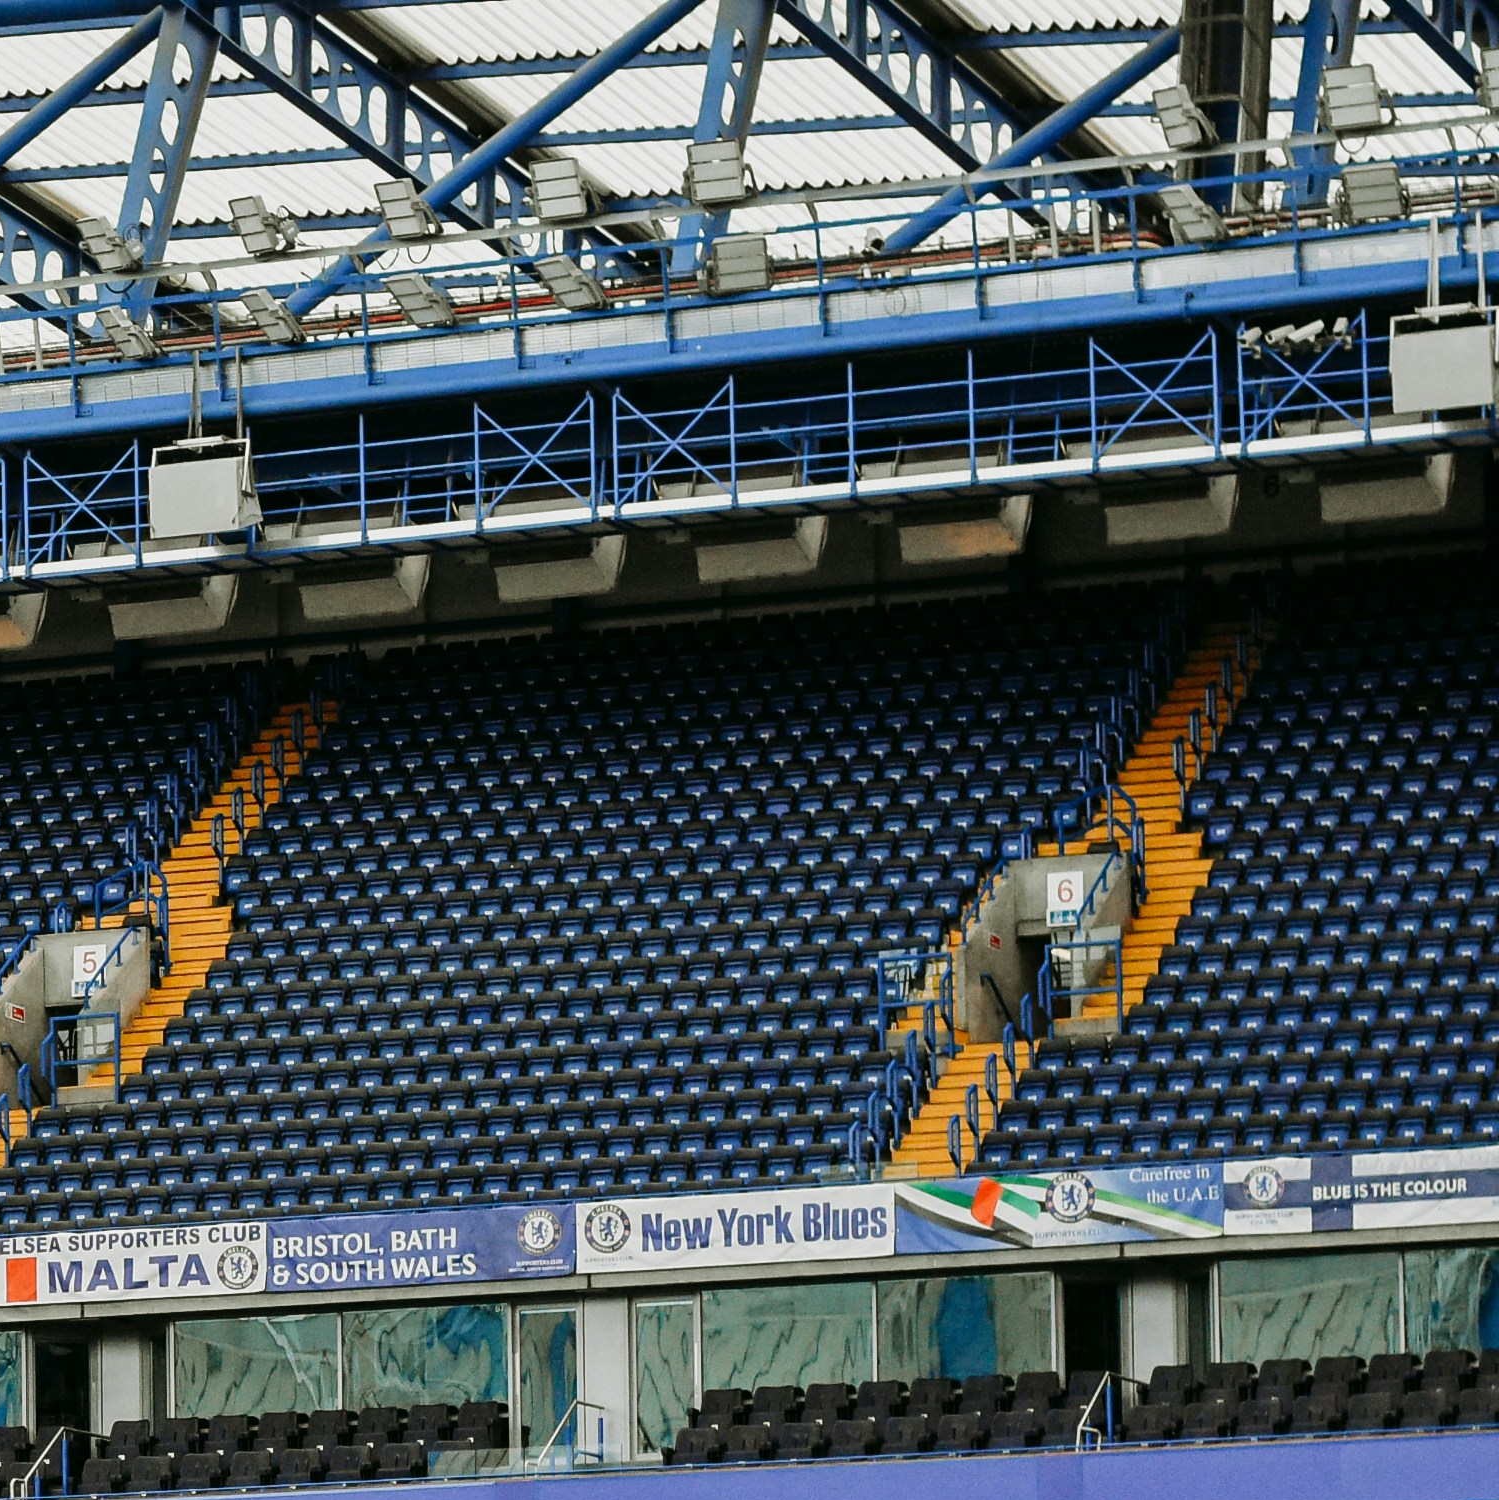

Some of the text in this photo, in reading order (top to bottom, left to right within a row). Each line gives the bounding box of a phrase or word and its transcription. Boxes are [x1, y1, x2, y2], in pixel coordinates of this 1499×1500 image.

[1057, 879, 1074, 903] 6
[82, 951, 98, 974] 5
[1052, 1172, 1087, 1185] CHELSEA
[1129, 1165, 1210, 1183] Carefree in
[1147, 1185, 1220, 1204] the U.A.E
[1312, 1178, 1467, 1201] BLUE IS THE COLOUR
[68, 1228, 201, 1252] SUPPORTERS
[207, 1225, 262, 1243] CLUB
[641, 1202, 888, 1252] New York Blues
[272, 1227, 457, 1258] BRISTOL, BATH
[47, 1253, 211, 1294] MALTA
[272, 1253, 477, 1286] & SOUTH WALES
